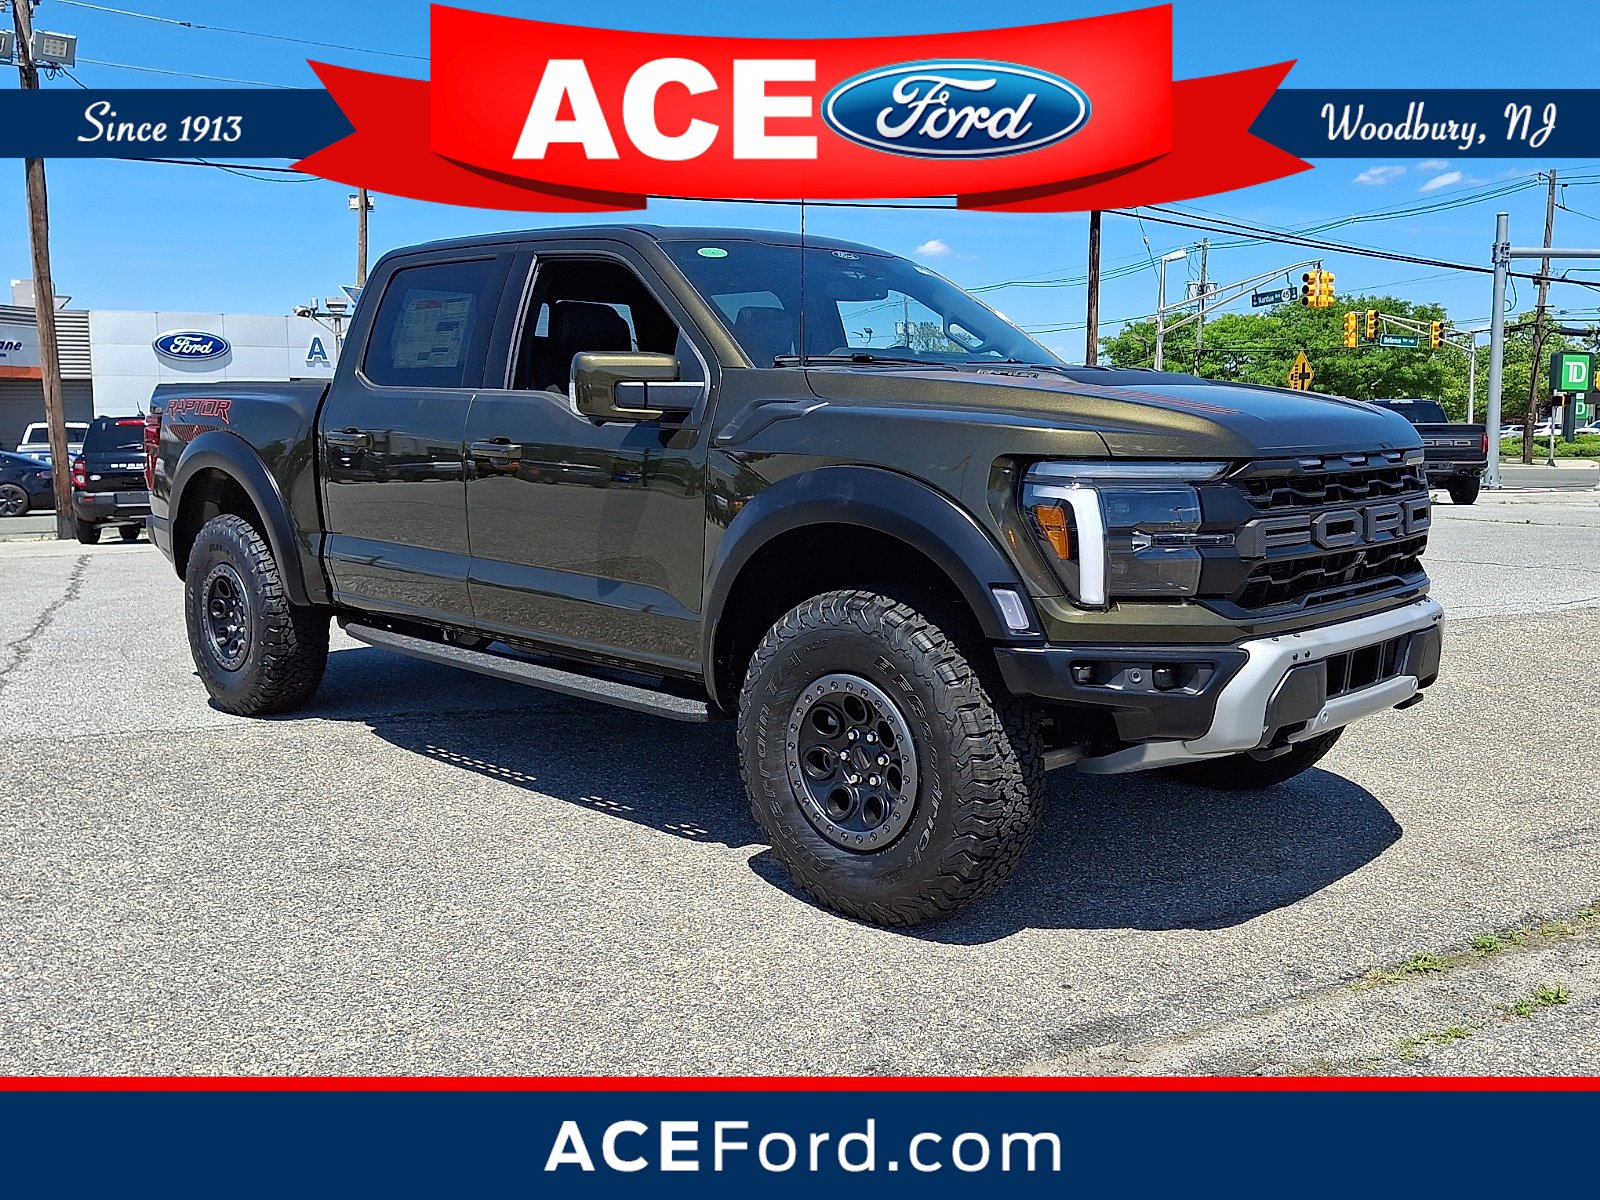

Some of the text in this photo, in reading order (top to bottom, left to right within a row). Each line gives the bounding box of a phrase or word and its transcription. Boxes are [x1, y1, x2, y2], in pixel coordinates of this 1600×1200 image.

[1282, 290, 1290, 299] 45
[169, 335, 213, 354] Ford
[1564, 361, 1587, 383] TD
[165, 398, 232, 425] RAPTOR
[1238, 497, 1432, 561] FORD
